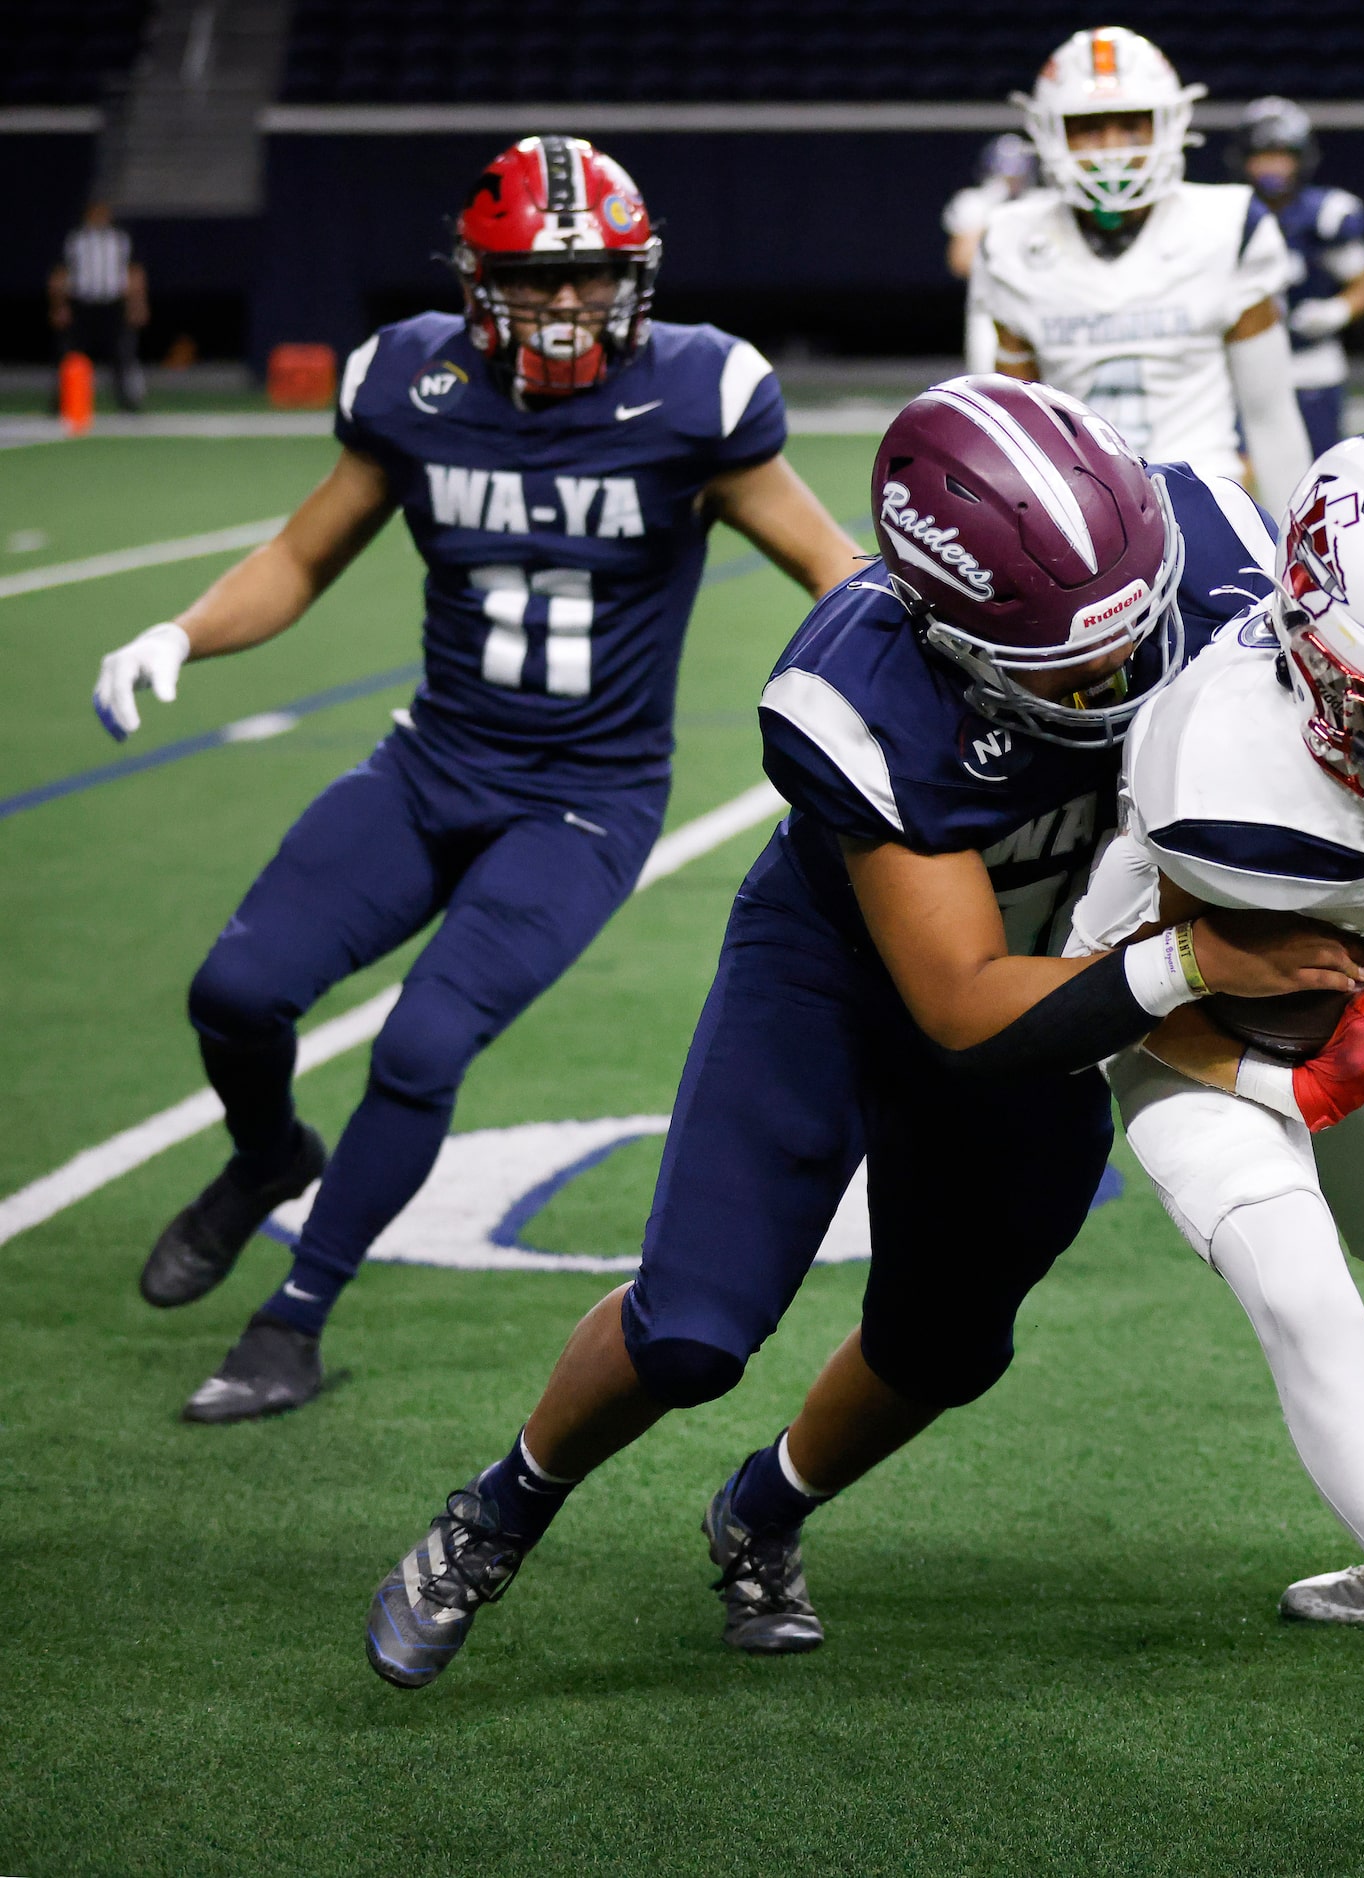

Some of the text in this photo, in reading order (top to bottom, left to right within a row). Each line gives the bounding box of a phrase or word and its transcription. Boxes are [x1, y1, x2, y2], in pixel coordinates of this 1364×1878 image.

[419, 372, 458, 398] N7
[425, 463, 646, 538] WA-YA
[881, 480, 995, 600] Raiders
[468, 565, 594, 697] 11
[1082, 588, 1143, 629] Riddell
[972, 728, 1013, 765] N7
